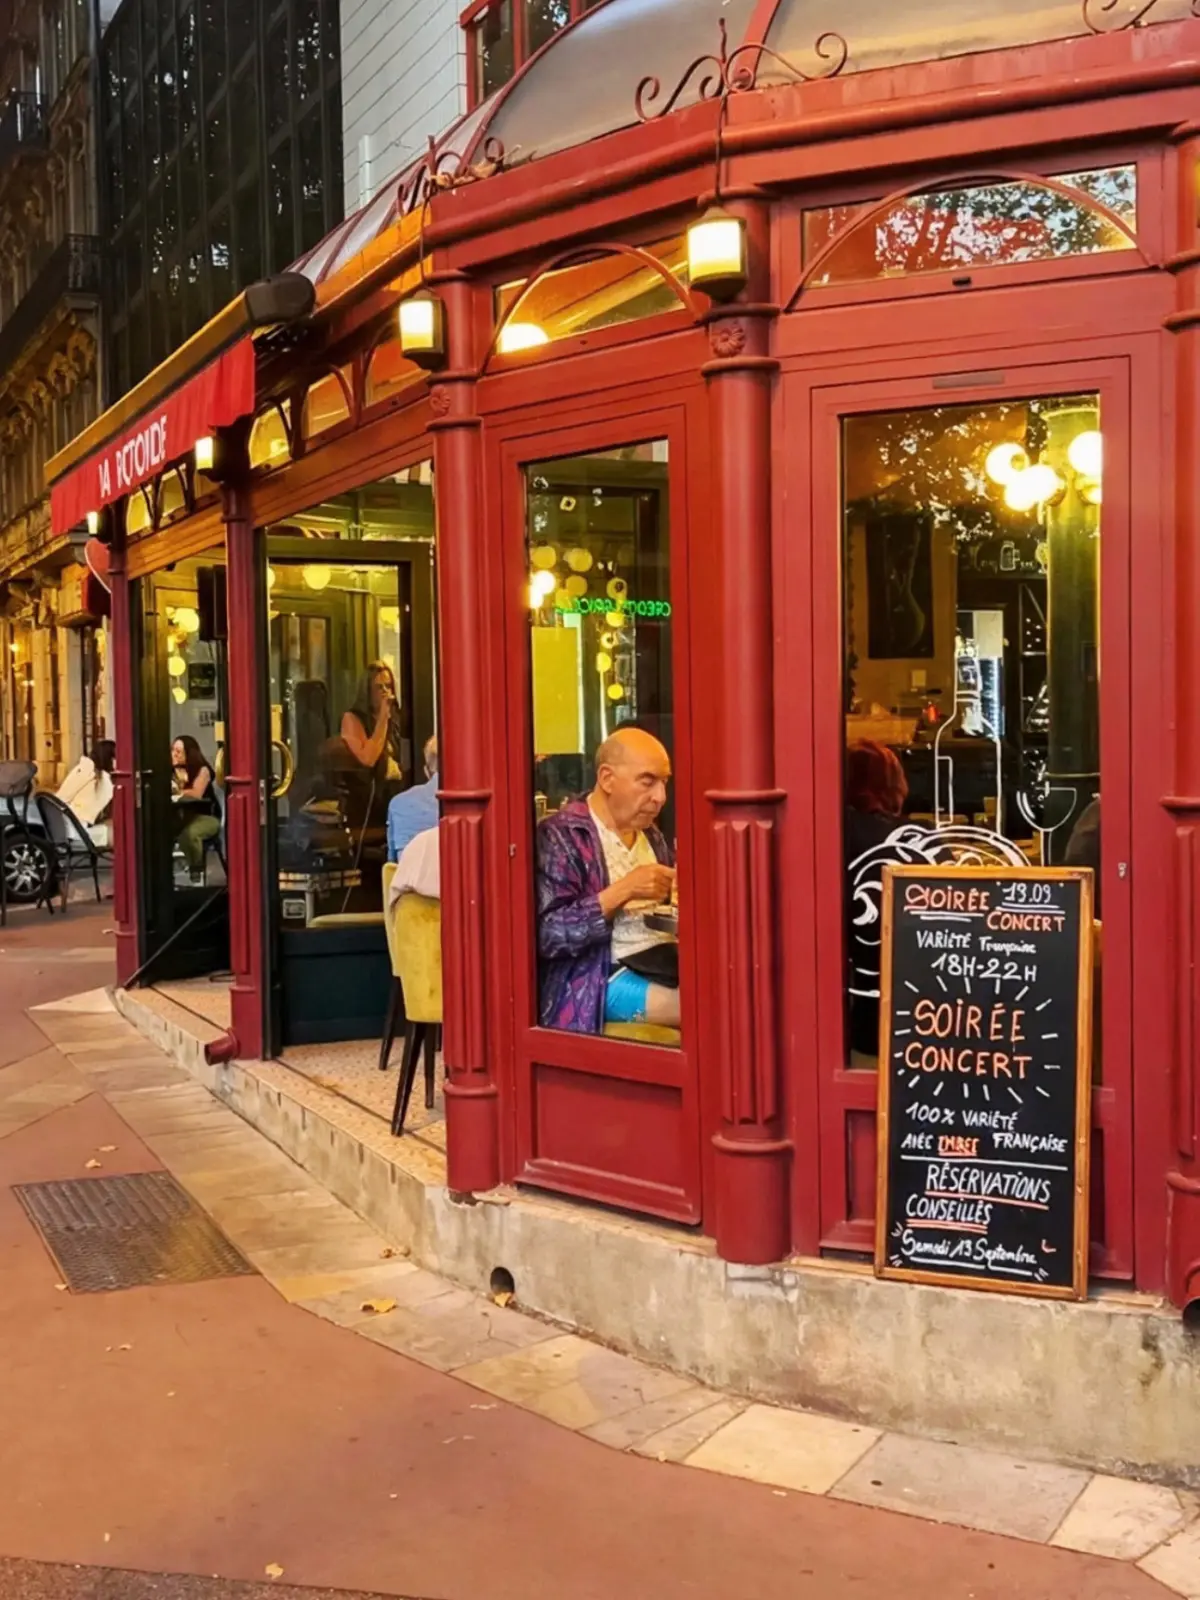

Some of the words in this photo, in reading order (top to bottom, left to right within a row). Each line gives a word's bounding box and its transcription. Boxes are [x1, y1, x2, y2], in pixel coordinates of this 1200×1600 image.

[986, 910, 1066, 932] CONCERT
[914, 998, 1026, 1042] SOIRÉE
[904, 1042, 1033, 1079] CONCERT
[905, 1101, 956, 1125] 100%
